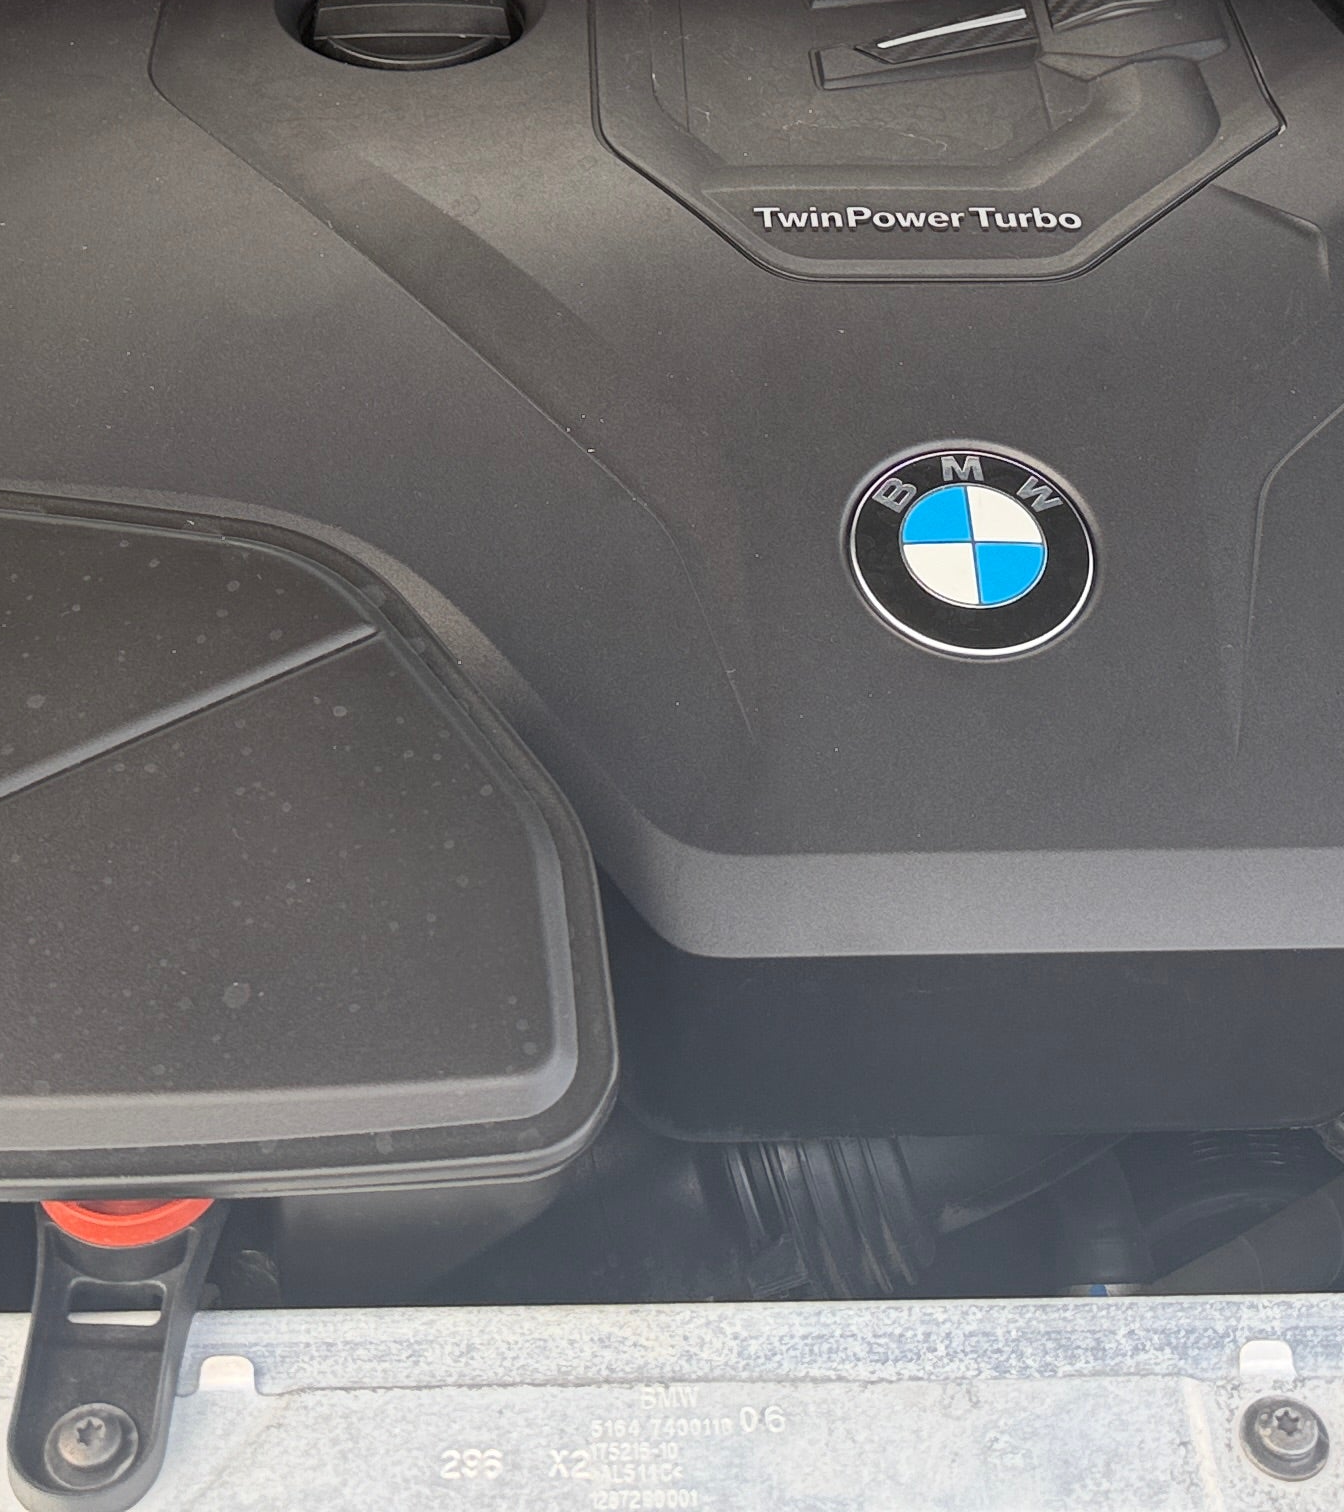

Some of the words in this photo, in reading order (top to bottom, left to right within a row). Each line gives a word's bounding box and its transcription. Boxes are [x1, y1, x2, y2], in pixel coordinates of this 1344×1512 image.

[753, 206, 965, 230] TwinPower
[968, 206, 1082, 230] Turbo
[872, 455, 1064, 514] BMW
[640, 1386, 699, 1409] BMW
[440, 1448, 504, 1480] 296
